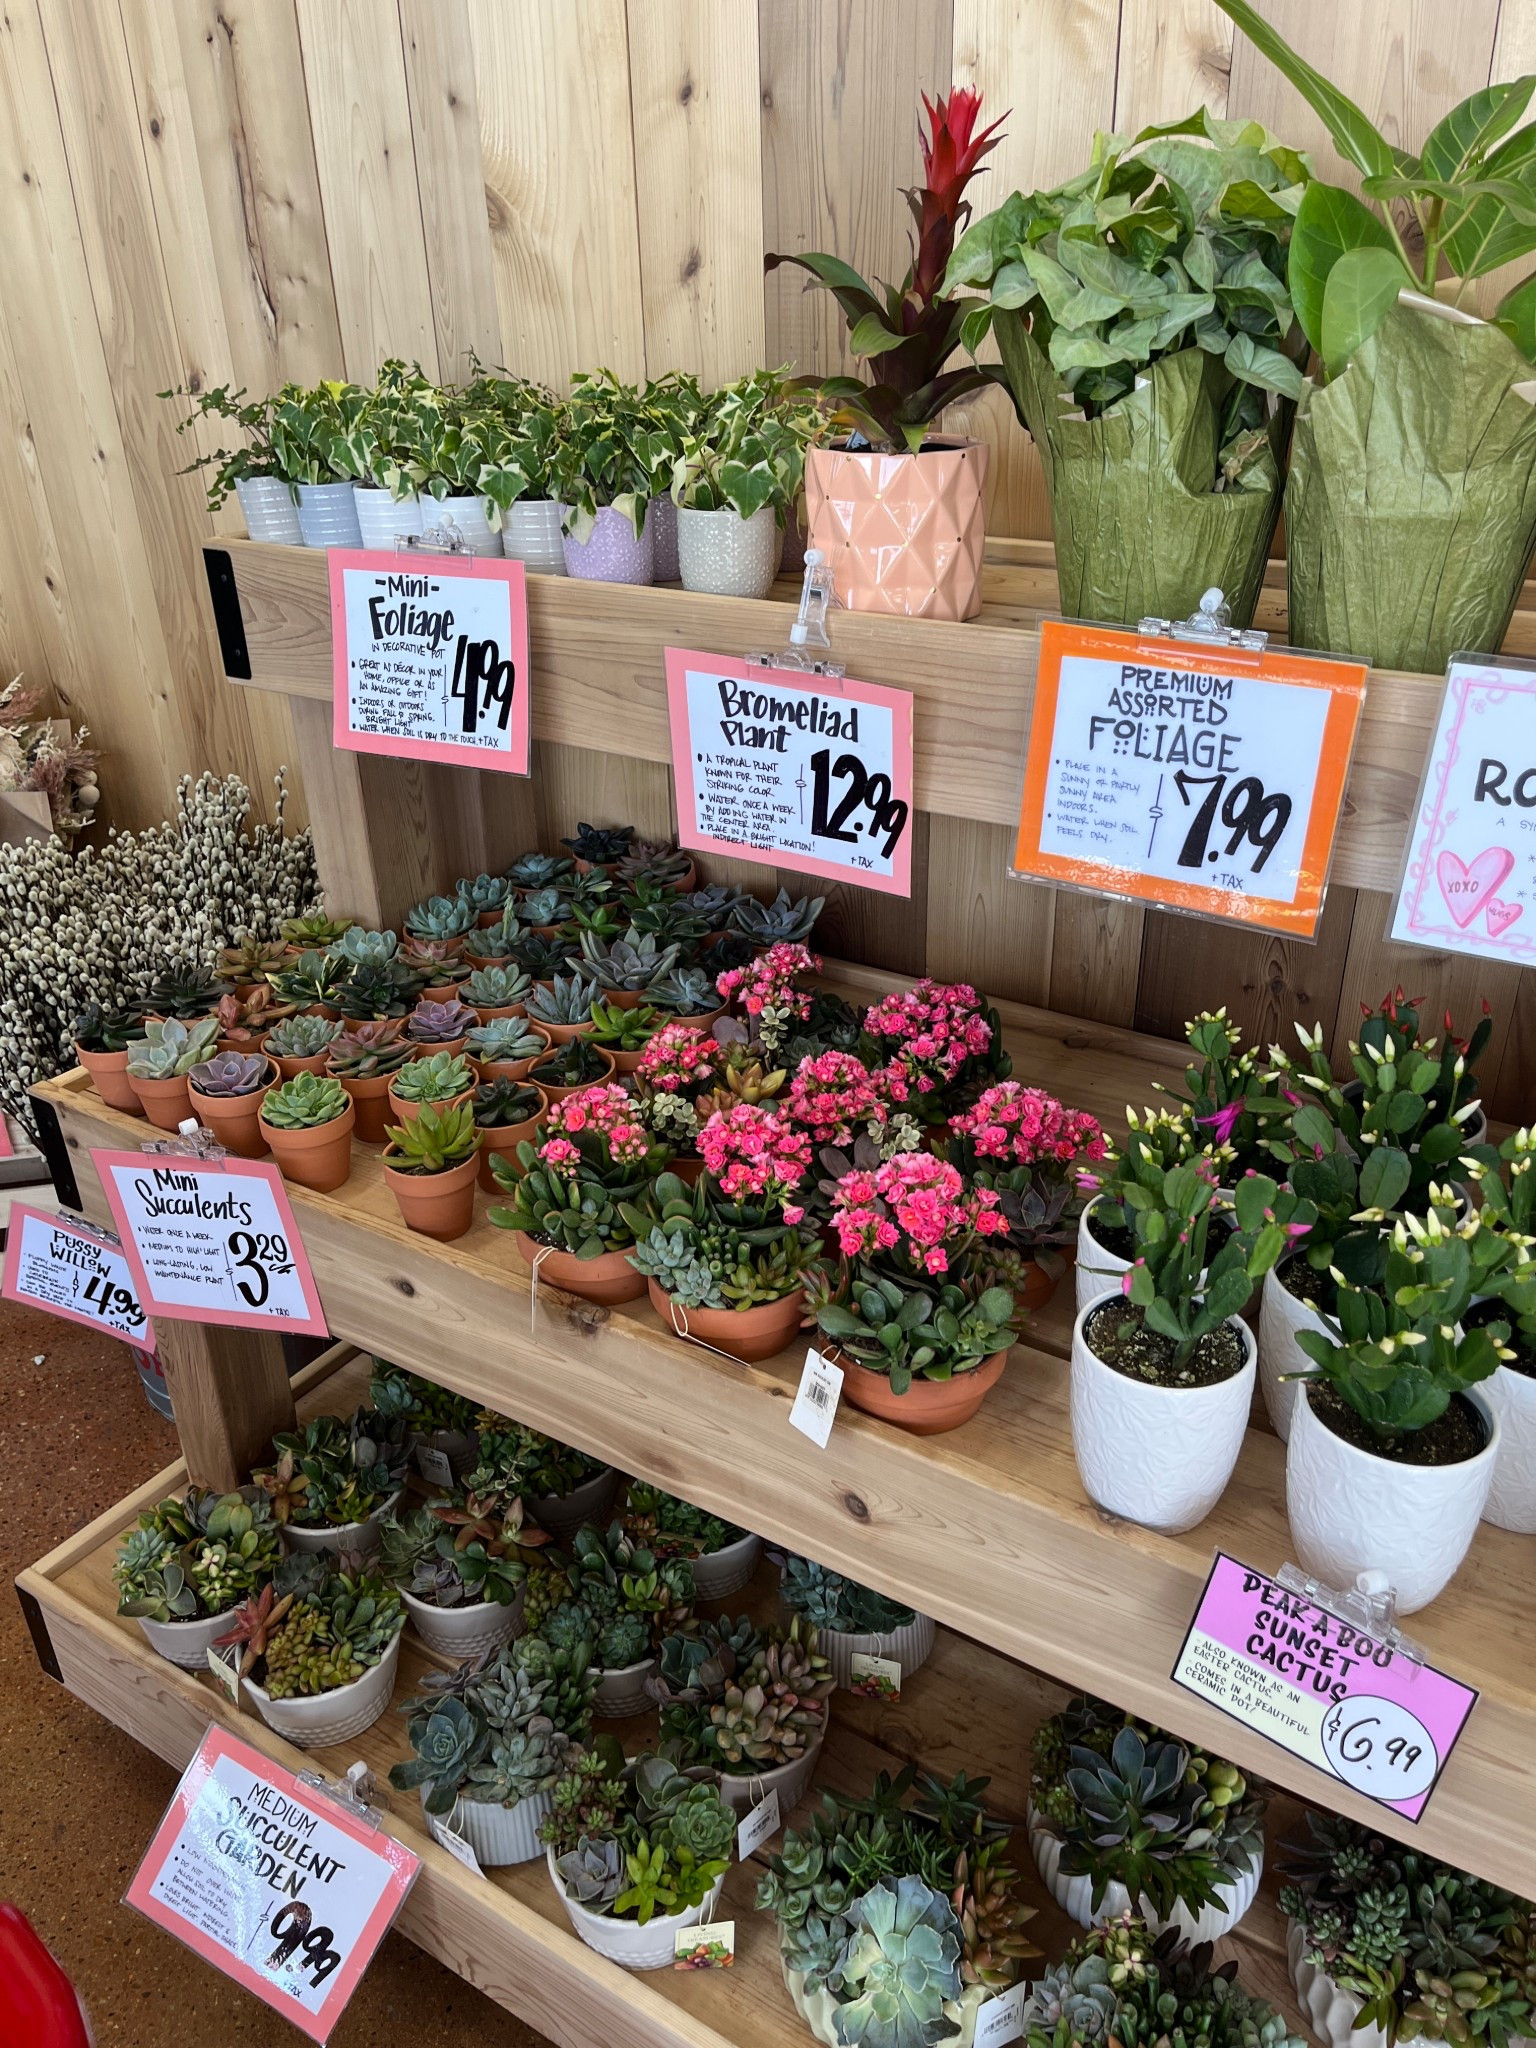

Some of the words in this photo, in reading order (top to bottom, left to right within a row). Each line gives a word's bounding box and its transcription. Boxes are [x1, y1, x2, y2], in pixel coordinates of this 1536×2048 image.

[368, 596, 455, 651] Foliage
[372, 643, 380, 652] IN
[382, 642, 426, 656] DECORATIVE
[432, 648, 446, 659] POT
[359, 658, 380, 671] GREAT
[384, 662, 392, 672] AS
[428, 668, 443, 681] YOUR
[360, 680, 368, 690] AN
[371, 682, 402, 696] AMAZING
[406, 688, 428, 701] GIFT!
[386, 676, 410, 686] OFFICE
[414, 680, 424, 688] OR
[428, 681, 436, 690] AS
[450, 634, 515, 733] 4.99
[1121, 665, 1234, 700] PREMIUM
[358, 696, 384, 708] INDOORS
[388, 700, 396, 708] OR
[398, 702, 424, 711] OUTDOORS
[358, 707, 378, 715] DURING
[382, 708, 396, 717] FALL
[718, 679, 859, 743] Bromeliad
[1108, 688, 1228, 726] ASSORTED
[359, 724, 379, 732] WATER
[382, 726, 400, 735] WHEN
[402, 727, 415, 736] SOIL
[418, 730, 423, 739] IS
[425, 732, 438, 741] DRY
[440, 732, 447, 741] TO
[448, 734, 460, 742] THE
[366, 716, 392, 725] BRIGHT
[394, 718, 413, 727] LIGHT
[720, 720, 792, 753] Plant
[1090, 716, 1242, 773] FOLIAGE
[706, 753, 712, 764] A
[716, 754, 752, 768] TROPICAL
[752, 760, 779, 772] PLANT
[1065, 760, 1090, 772] PLACE
[1096, 766, 1106, 774] IN
[1111, 768, 1118, 776] A
[704, 766, 732, 779] KNOWN
[736, 772, 752, 782] FOR
[756, 774, 782, 786] THEIR
[1060, 772, 1090, 788] SUNNY
[1096, 778, 1108, 787] OR
[1111, 780, 1140, 796] PARTLY
[706, 779, 744, 793] STRIKING
[748, 786, 775, 798] COLOR
[1059, 786, 1088, 802] SUNNY
[1092, 791, 1117, 804] AREA
[705, 804, 714, 815] BY
[752, 812, 778, 824] WATER
[708, 793, 740, 806] WATER
[742, 800, 761, 810] ONCE
[763, 802, 768, 810] A
[772, 804, 796, 815] WEEK
[810, 748, 908, 860] 12.99
[700, 812, 714, 822] THE
[719, 816, 750, 828] CENTER
[1056, 813, 1089, 825] WATER
[1094, 819, 1117, 828] WHEN
[1120, 823, 1138, 834] SOIL
[1173, 768, 1292, 874] 7.99
[1496, 817, 1505, 827] A
[707, 824, 728, 834] PLACE
[742, 829, 748, 838] A
[750, 833, 778, 843] BRIGHT
[780, 838, 816, 852] LOCATION!
[712, 833, 748, 845] INDIRECT
[750, 843, 775, 852] LIGHT
[1057, 826, 1083, 838] FEELS
[1447, 880, 1479, 894] XOXO
[1488, 906, 1512, 921] HUGS
[152, 1168, 199, 1193] Mini
[134, 1178, 252, 1226] Succulents
[142, 1225, 164, 1235] WATER
[166, 1228, 184, 1238] ONCE
[186, 1230, 191, 1239] A
[192, 1232, 214, 1240] WEEK
[54, 1230, 102, 1259] PUSSY
[148, 1242, 174, 1252] MEDIUM
[175, 1246, 184, 1254] TO
[203, 1248, 220, 1256] LIGHT
[50, 1242, 112, 1278] WILLOW
[200, 1264, 213, 1272] LOW
[154, 1270, 201, 1282] MAINTENANCE
[205, 1276, 224, 1286] PLANT
[1254, 1610, 1360, 1678] SUNSET
[1194, 1646, 1230, 1672] EASTER
[1246, 1634, 1348, 1703] CACTUS
[1185, 1666, 1226, 1696] CERAMIC
[1202, 1640, 1226, 1659] ALSO
[1230, 1656, 1267, 1684] KNOWN
[1270, 1682, 1283, 1693] AS
[1287, 1694, 1301, 1704] AN
[1194, 1662, 1227, 1686] COMES
[1230, 1683, 1242, 1695] IN
[1245, 1692, 1252, 1702] A
[1255, 1698, 1310, 1736] BEAUTIFUL
[248, 1782, 318, 1838] MEDIUM
[217, 1796, 346, 1884] SUCCULENT
[187, 1848, 201, 1860] LOW
[172, 1874, 198, 1897] BETWEEN
[180, 1859, 190, 1868] DO
[192, 1866, 204, 1877] NOT
[206, 1878, 221, 1890] OVER
[177, 1868, 194, 1882] ALLOW
[194, 1879, 206, 1892] SOIL
[216, 1895, 228, 1908] DRY
[163, 1892, 181, 1907] DIRECT
[200, 1920, 220, 1938] PARTIAL
[165, 1884, 181, 1899] LOVES
[181, 1896, 201, 1912] BRIGHT
[203, 1912, 226, 1929] INDIRECT
